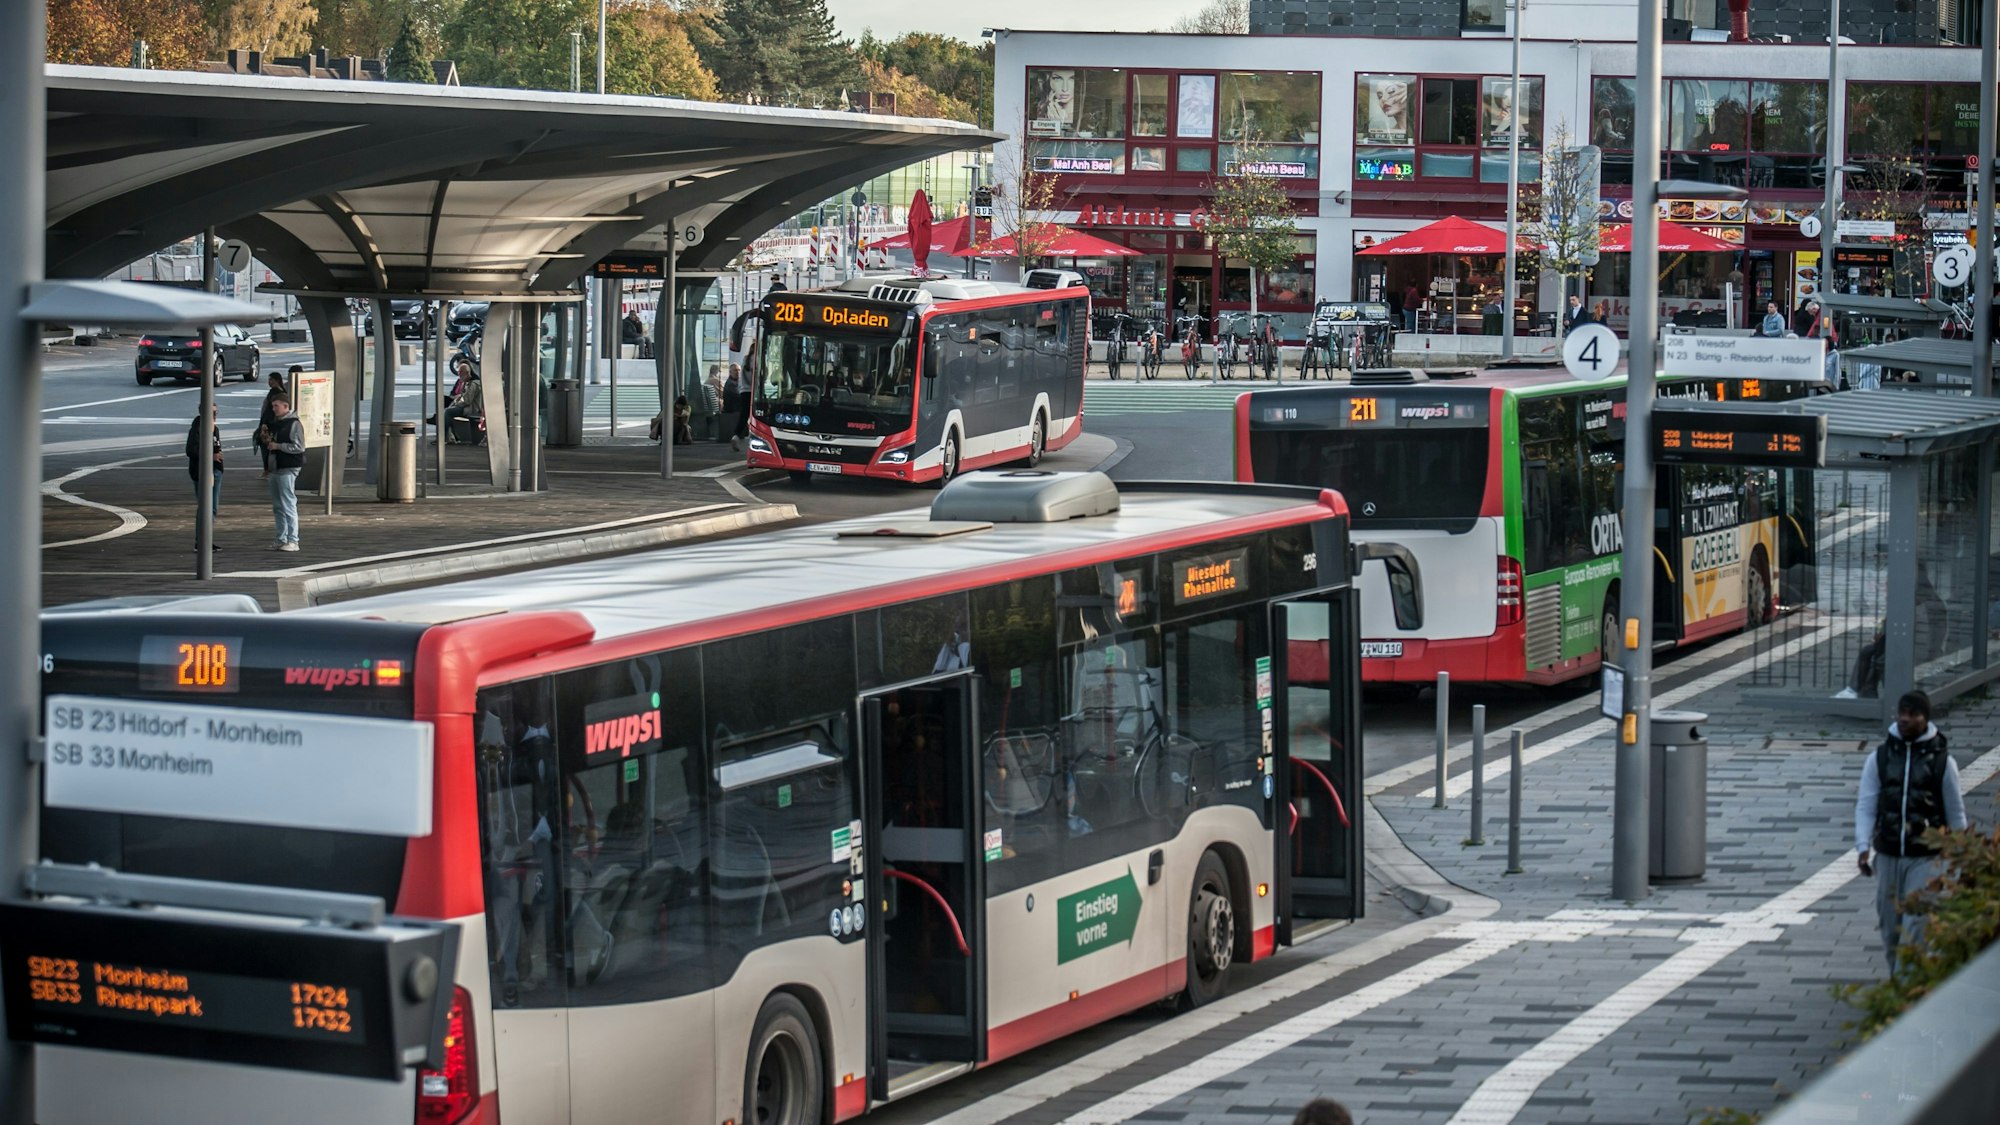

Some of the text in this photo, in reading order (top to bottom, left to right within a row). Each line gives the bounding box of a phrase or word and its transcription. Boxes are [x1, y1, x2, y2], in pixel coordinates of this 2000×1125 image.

[1710, 143, 1730, 151] OPEN
[1071, 160, 1090, 170] Anh
[1259, 164, 1279, 174] Anh
[1279, 164, 1305, 175] Beau
[1360, 162, 1413, 175] Mai Anh B
[685, 225, 697, 242] 6
[1807, 220, 1814, 234] 1
[227, 245, 241, 266] 7
[1943, 256, 1959, 280] 3
[774, 302, 889, 328] 203 Opladen
[1320, 305, 1358, 313] FITNESS
[1578, 335, 1603, 371] 4
[1667, 338, 1737, 349] 208 Wiesdorf
[1666, 351, 1674, 360] N
[1676, 352, 1688, 361] 23
[1695, 352, 1721, 363] Bürrig
[1730, 354, 1774, 364] Rheindorf
[1781, 355, 1812, 365] Hitdorf
[755, 409, 764, 417] 121
[1285, 408, 1298, 420] 110
[1350, 398, 1377, 421] 211
[1401, 402, 1450, 420] wupsi
[1663, 429, 1801, 443] 208 Wiesdorf 1 Min
[1663, 439, 1801, 452] 208 Wiesdorf 21 Min
[808, 445, 842, 456] MAN
[1591, 512, 1625, 556] ORTA
[1187, 559, 1231, 582] Wiesdorf
[1303, 552, 1317, 572] 296
[1183, 575, 1236, 599] Rheinallee
[178, 643, 226, 686] 208
[284, 659, 371, 692] wupsi
[53, 706, 84, 730] SB
[90, 708, 117, 733] 23
[119, 712, 188, 739] Hitdorf
[206, 720, 304, 747] Monheim
[585, 691, 662, 758] wupsi
[52, 741, 214, 776] SB 33 Monheim
[1075, 892, 1119, 924] Einstieg
[1076, 921, 1108, 947] vorne
[28, 955, 349, 1009] SB23 Monheim 17:24
[29, 978, 352, 1034] SB33 Rheinpark 17:32
